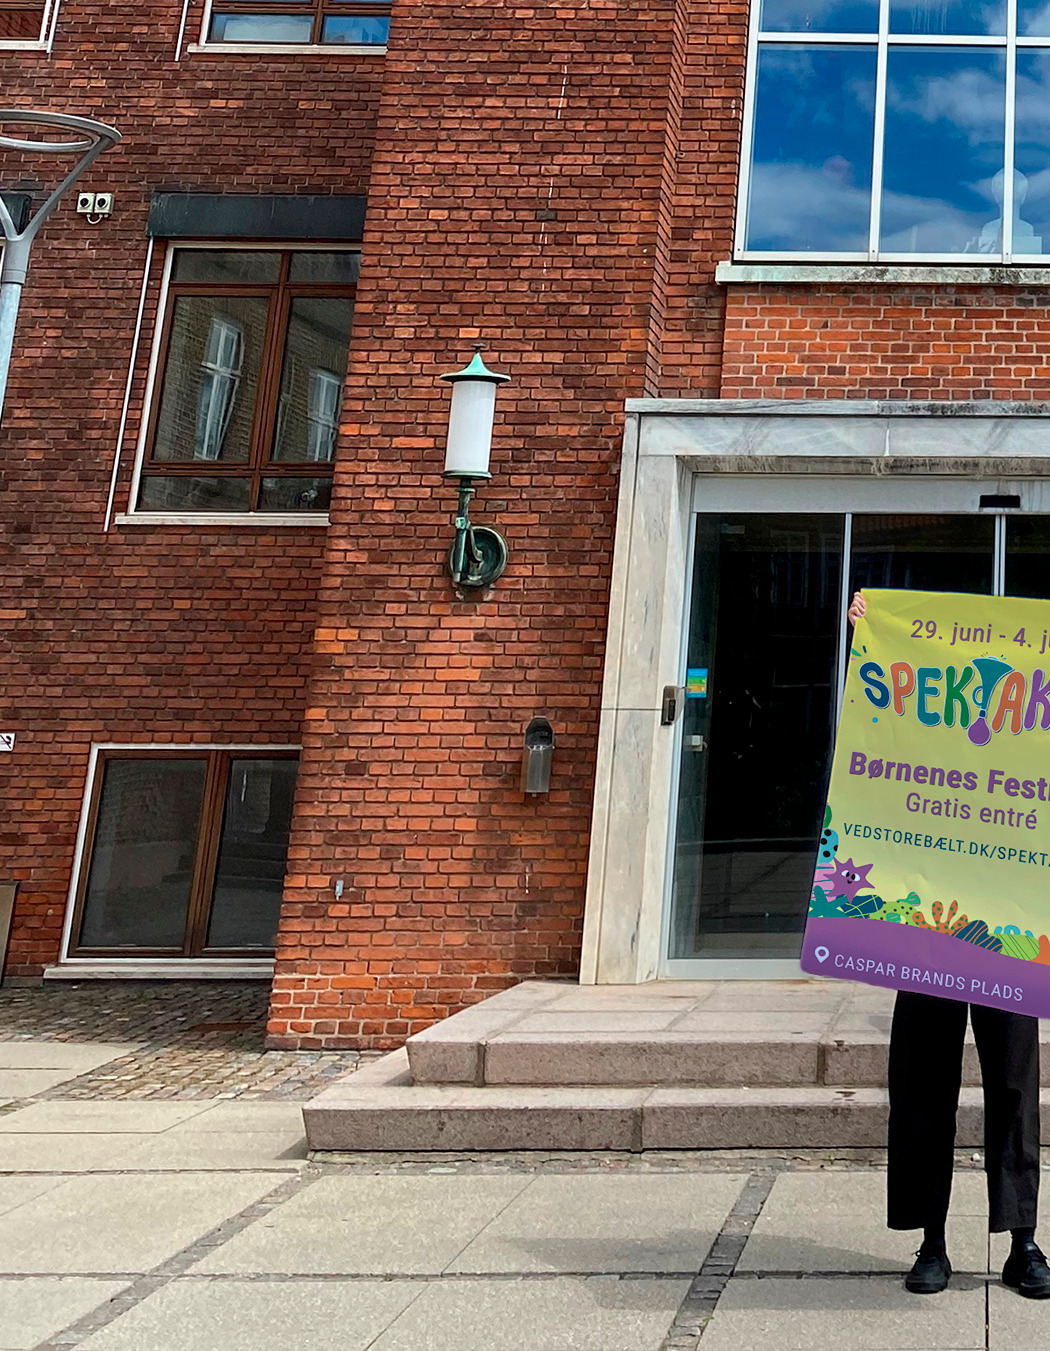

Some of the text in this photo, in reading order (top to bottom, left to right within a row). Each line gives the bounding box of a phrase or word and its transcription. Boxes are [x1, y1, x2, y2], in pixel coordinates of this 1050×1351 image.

[910, 619, 943, 640] 29.
[950, 623, 992, 645] juni
[1013, 628, 1032, 648] 4.
[849, 751, 978, 791] Børnenes
[906, 792, 1038, 830] Gratis entré
[834, 954, 1024, 1002] CASPAR BRANDS PLADS
